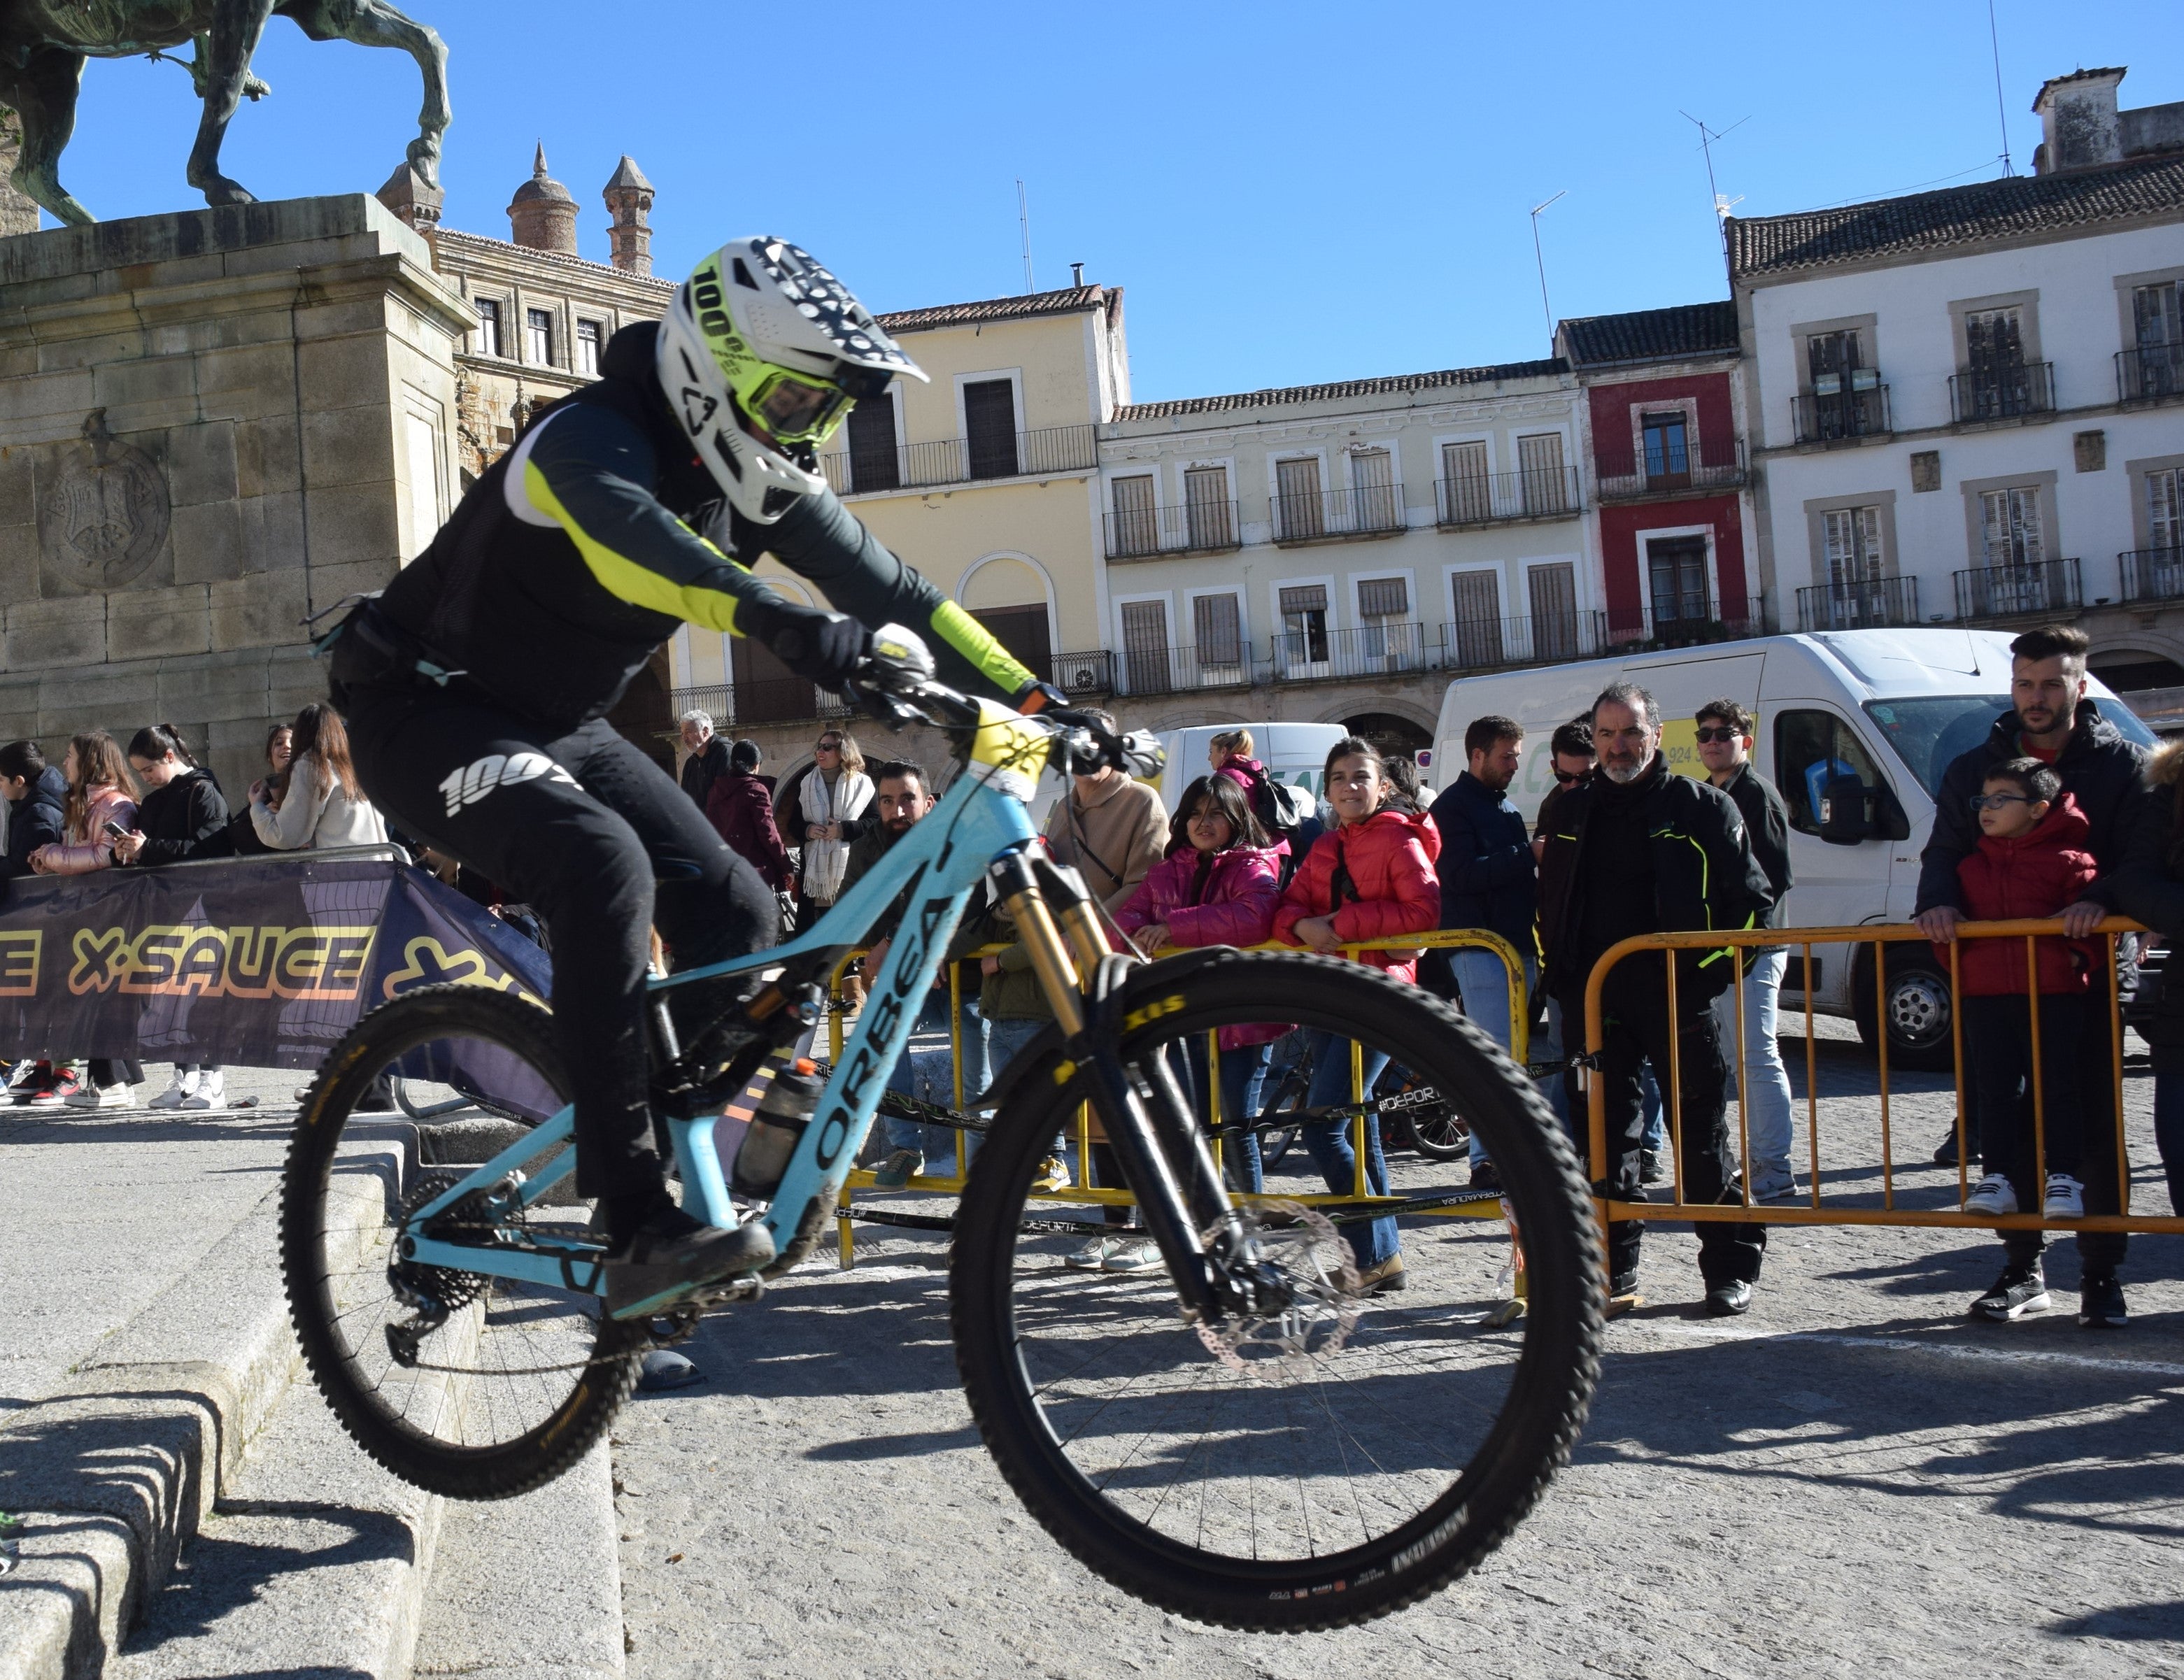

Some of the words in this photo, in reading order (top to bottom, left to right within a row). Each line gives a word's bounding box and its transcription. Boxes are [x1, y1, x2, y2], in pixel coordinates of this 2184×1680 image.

[1669, 746, 1692, 764] 924
[816, 896, 953, 1171] ORBEA
[1379, 1087, 1440, 1112] #DEPOR
